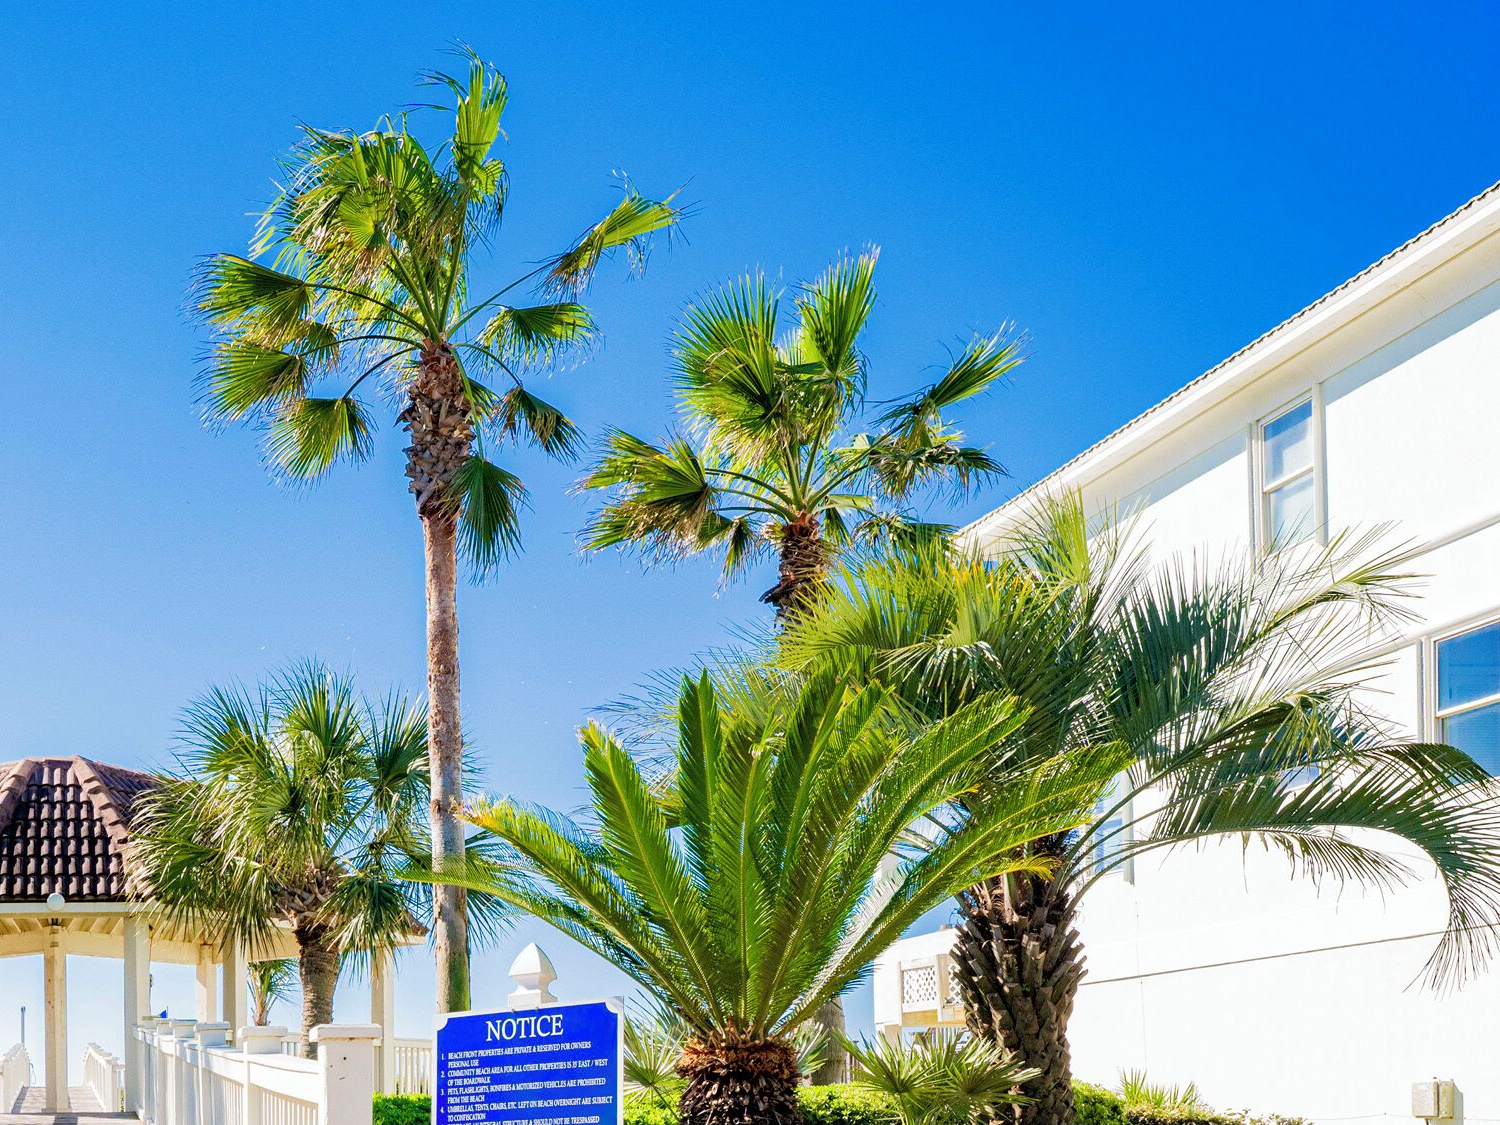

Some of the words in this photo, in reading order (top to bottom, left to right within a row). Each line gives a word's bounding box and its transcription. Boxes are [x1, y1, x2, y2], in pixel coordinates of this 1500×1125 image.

[486, 1014, 564, 1042] NOTICE
[478, 1048, 504, 1057] PROPERTIES
[514, 1046, 532, 1054] PRIVATE
[537, 1044, 560, 1052] RESERVED
[561, 1042, 570, 1050] FOR
[571, 1041, 592, 1050] OWNERS
[448, 1060, 470, 1068] PERSONAL
[448, 1069, 475, 1077] COMMUNITY
[523, 1064, 538, 1072] OTHER
[540, 1062, 566, 1070] PROPERTIES
[594, 1058, 608, 1066] WEST
[464, 1076, 490, 1085] BOARDWALK
[490, 1084, 511, 1092] BONFIRES
[516, 1082, 544, 1090] MOTORIZED
[577, 1078, 606, 1086] PROHIBITED
[592, 1096, 612, 1104] SUBJECT
[454, 1113, 486, 1121] CONFISCATION
[571, 1116, 600, 1124] TRESPASSED
